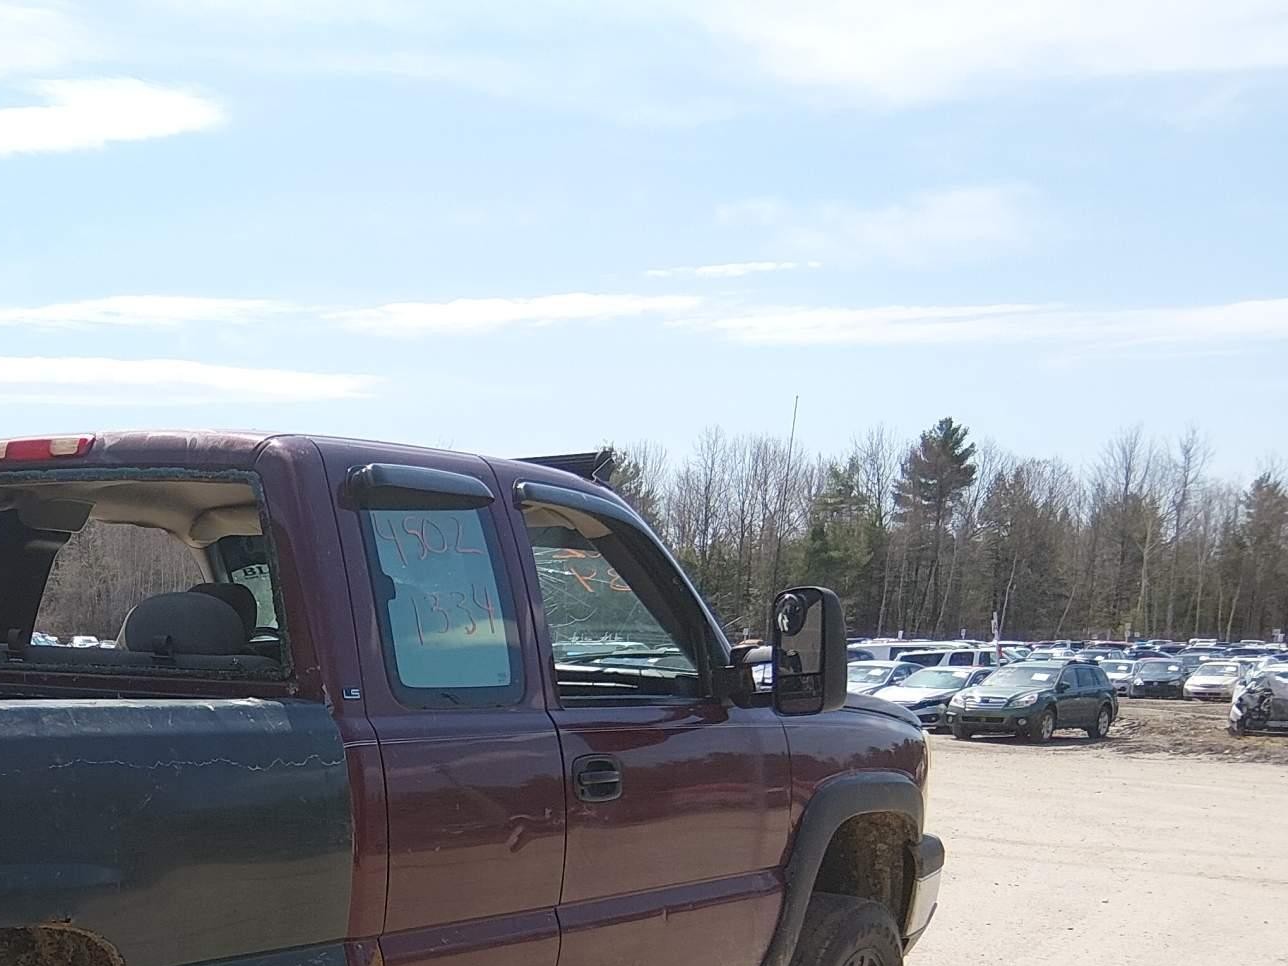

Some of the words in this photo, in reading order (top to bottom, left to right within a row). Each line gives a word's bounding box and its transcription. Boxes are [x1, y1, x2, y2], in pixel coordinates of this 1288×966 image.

[372, 513, 486, 567] 4502
[410, 583, 496, 646] 1334
[342, 688, 361, 700] LS
